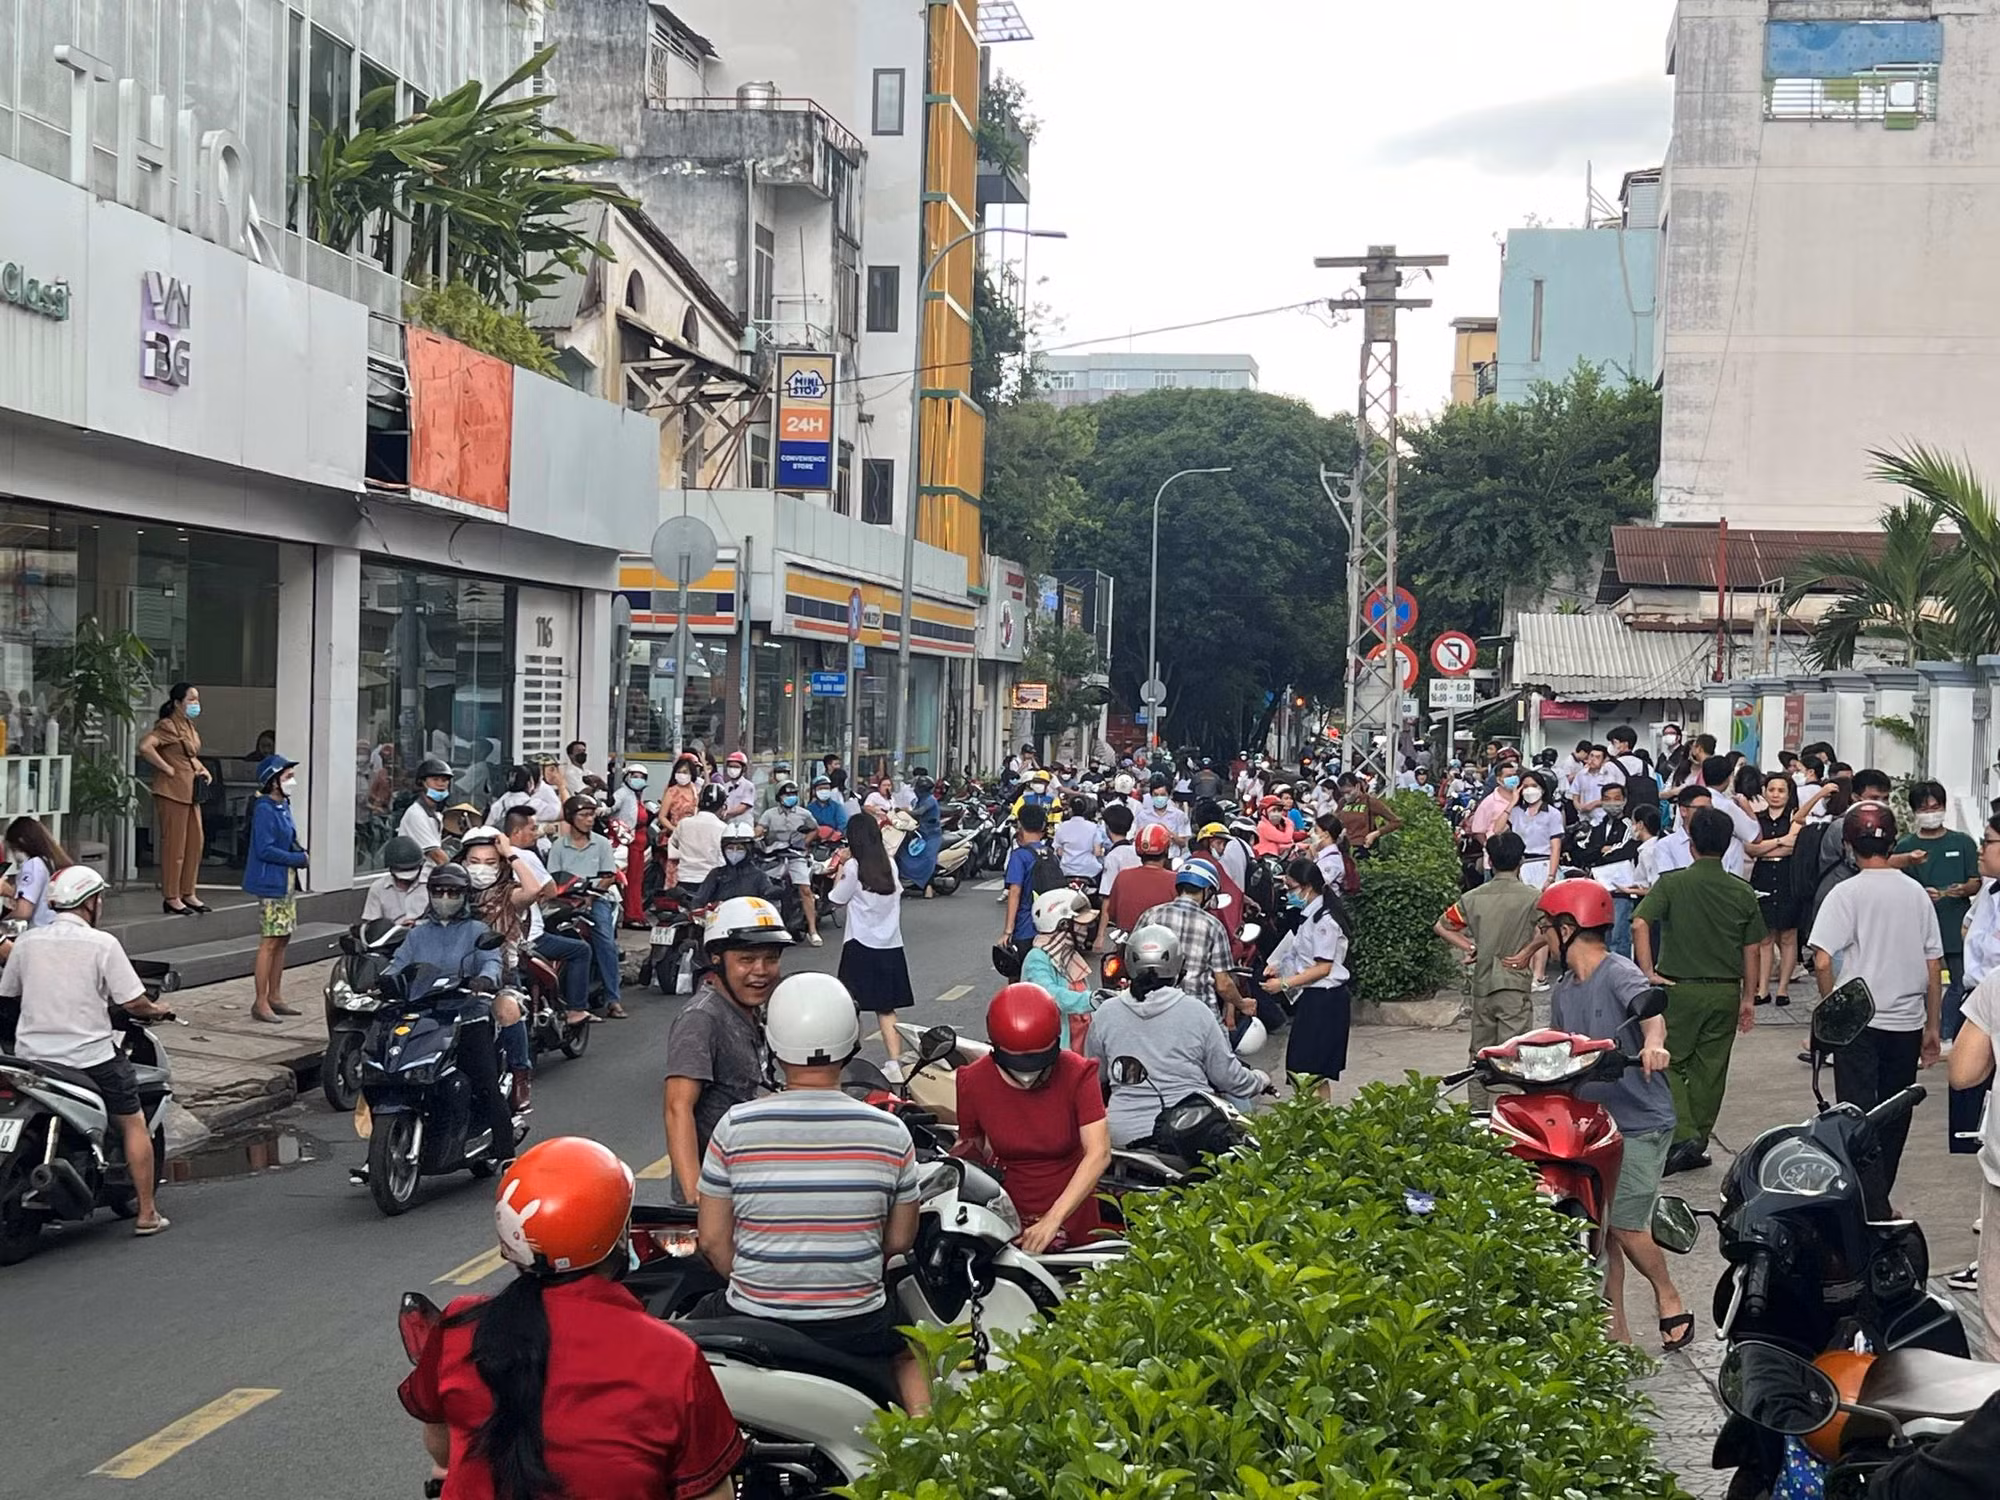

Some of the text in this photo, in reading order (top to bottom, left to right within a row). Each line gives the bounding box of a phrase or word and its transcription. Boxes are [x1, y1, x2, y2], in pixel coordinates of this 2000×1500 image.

[145, 271, 191, 328] VN
[144, 331, 191, 386] BG
[794, 377, 820, 386] MINI
[793, 387, 820, 395] STOP
[786, 416, 823, 433] 24H
[780, 454, 826, 463] CONVENIENCE
[535, 616, 554, 648] 116
